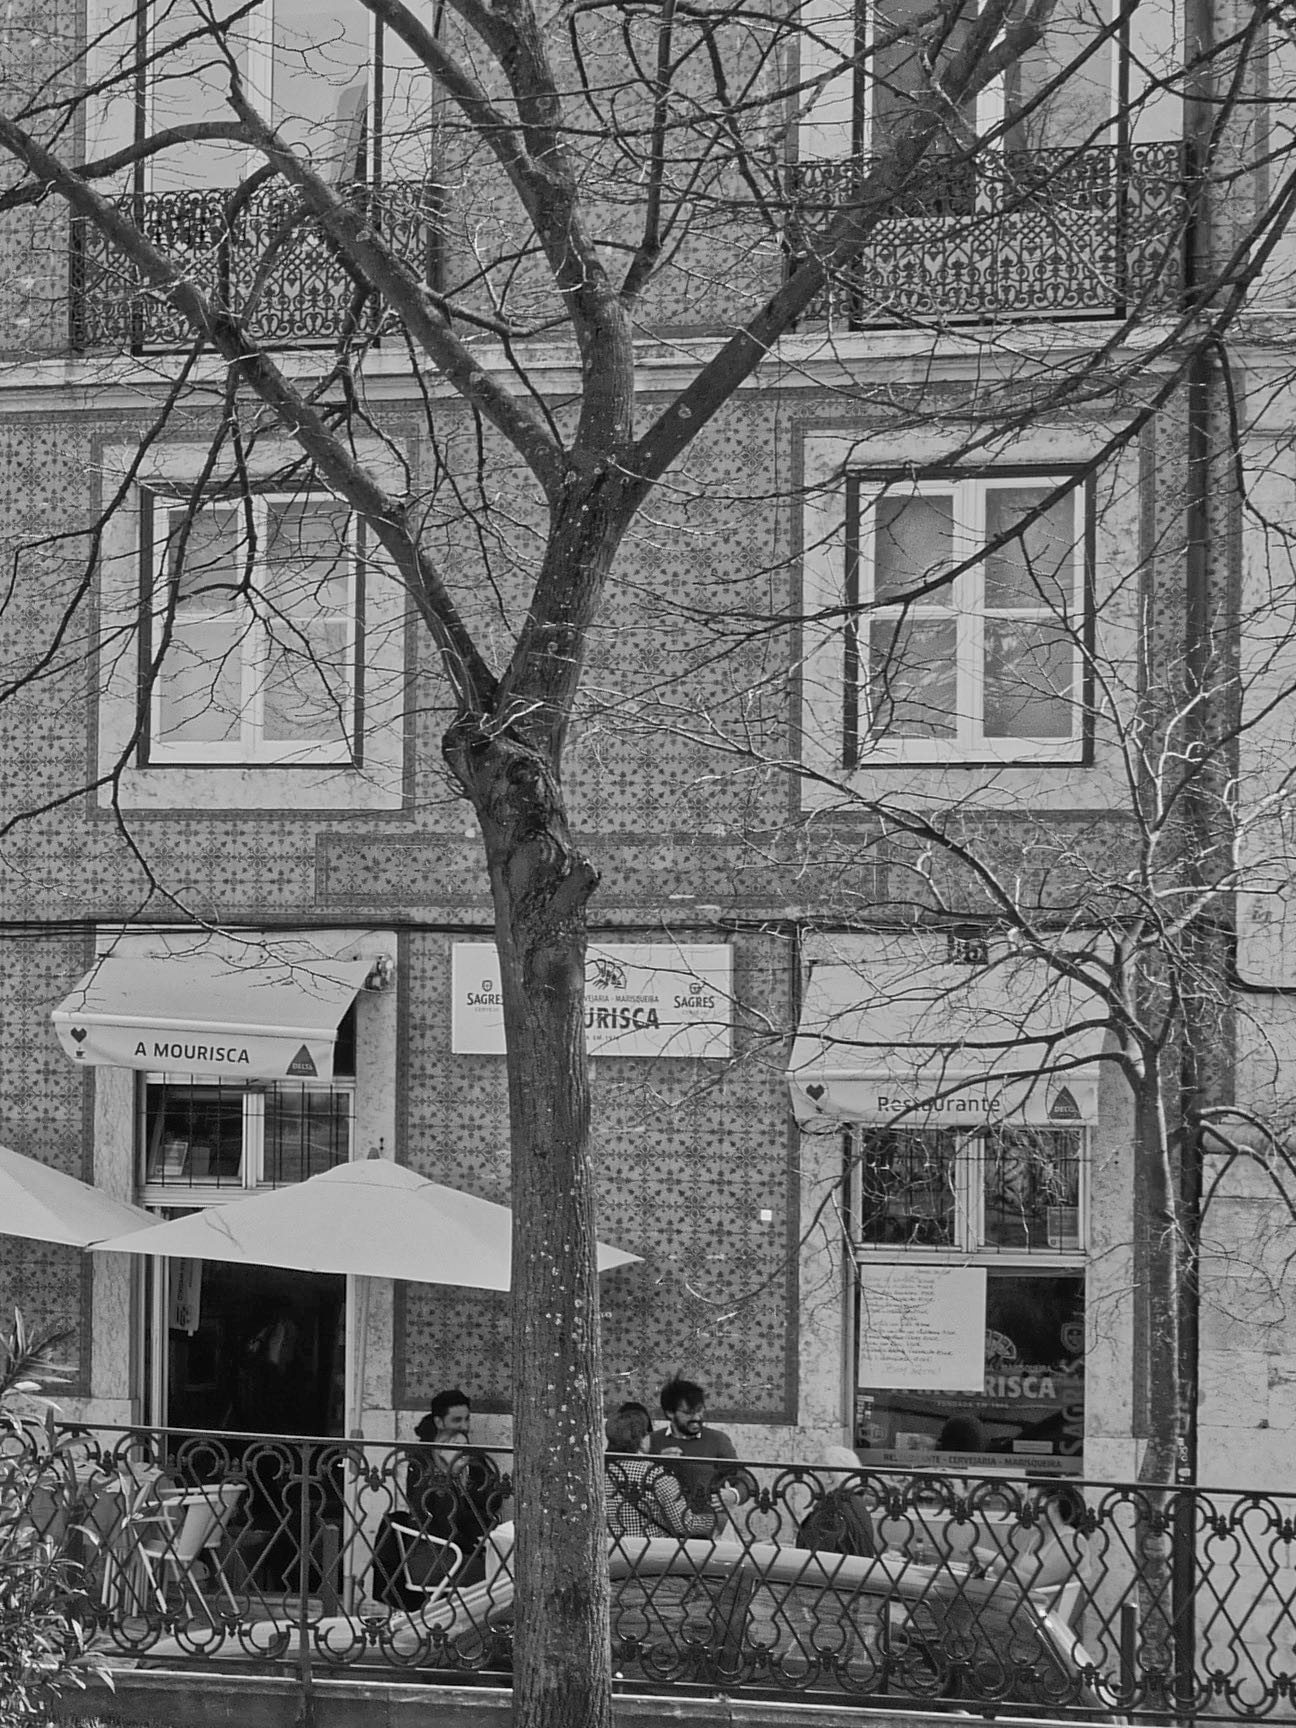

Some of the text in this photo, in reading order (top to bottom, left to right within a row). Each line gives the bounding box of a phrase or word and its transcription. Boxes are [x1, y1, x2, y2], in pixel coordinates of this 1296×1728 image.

[466, 991, 505, 1006] SAGRE
[673, 994, 716, 1010] SAGRES
[585, 1007, 661, 1030] URISCA
[134, 1041, 250, 1065] A MOURISCA
[877, 1095, 1001, 1114] Restaurante
[948, 1455, 997, 1466] CERVEJARIA
[1004, 1457, 1063, 1468] MARISQUEIRA
